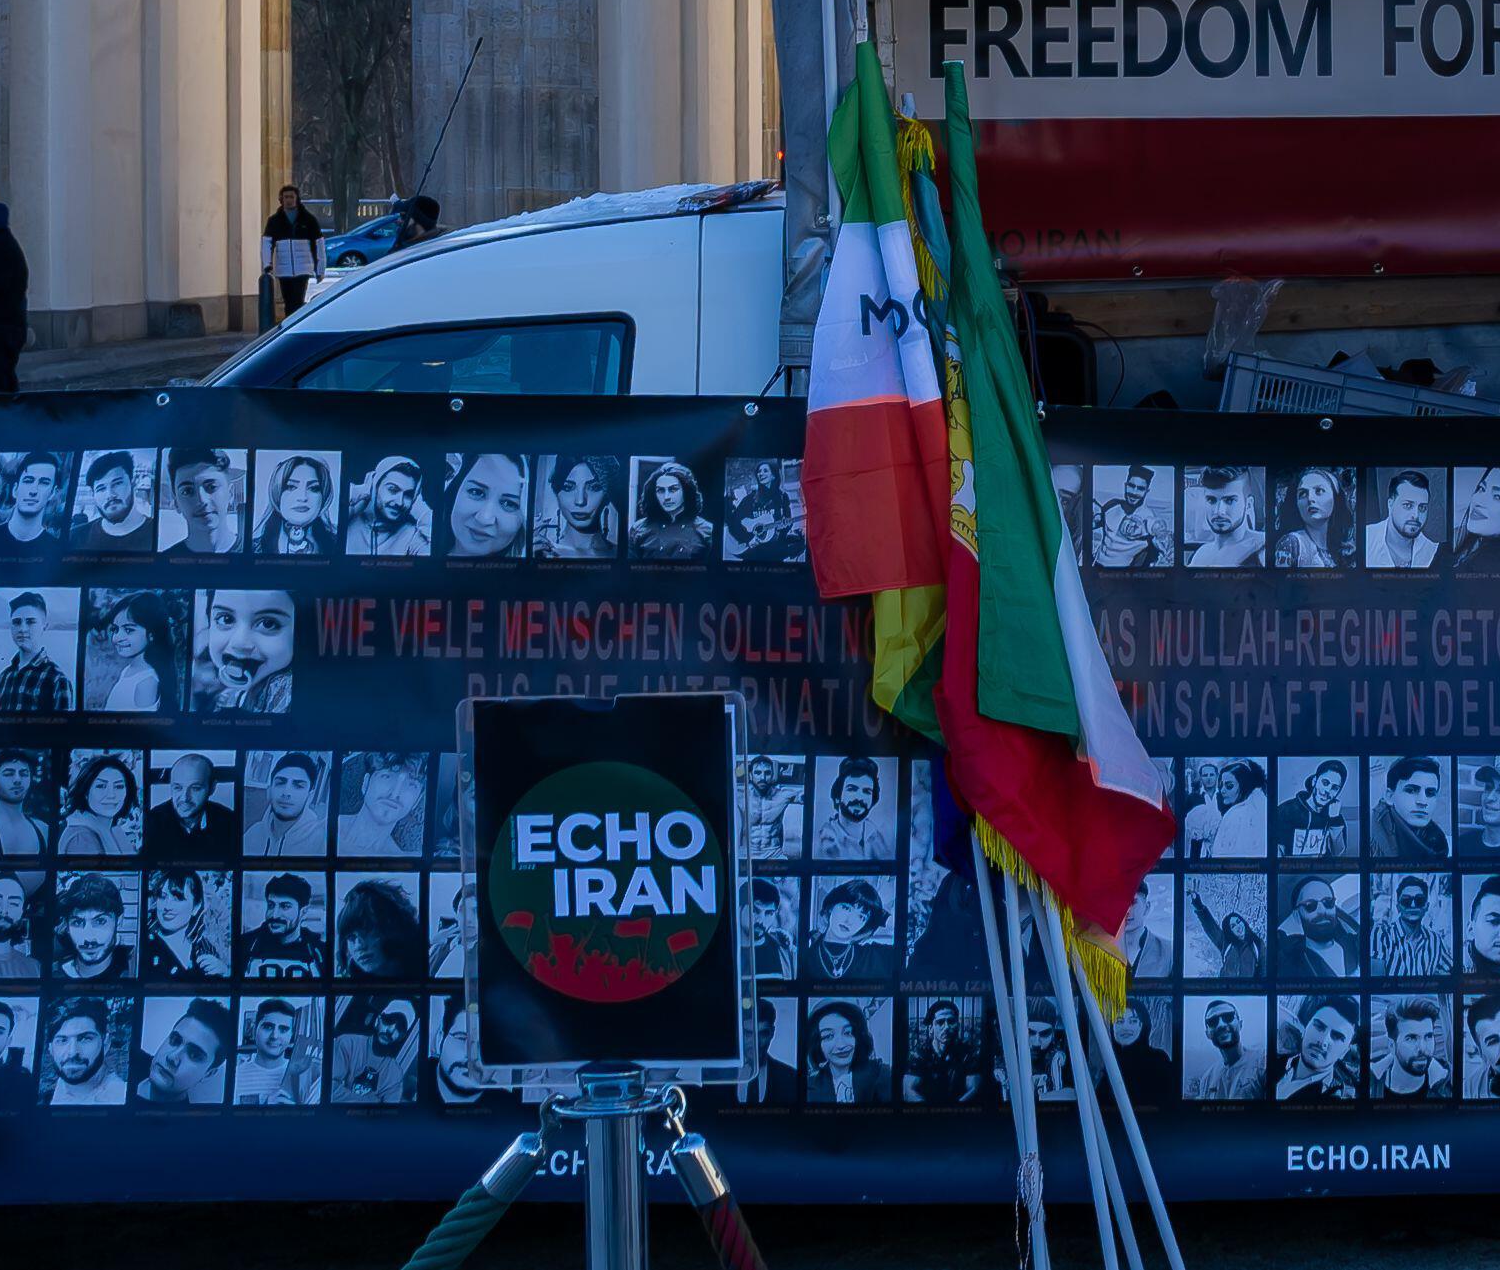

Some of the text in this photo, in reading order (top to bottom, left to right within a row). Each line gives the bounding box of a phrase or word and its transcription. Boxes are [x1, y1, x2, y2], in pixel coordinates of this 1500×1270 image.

[316, 598, 376, 657] WIE
[391, 598, 485, 659] VIELE
[500, 600, 684, 661] MENSCHEN
[697, 602, 825, 662] SOLLEN
[1150, 609, 1418, 667] MULLAH-REGIME
[516, 810, 707, 864] ECHO
[553, 865, 717, 917] IRAN
[1287, 1144, 1451, 1171] ECHO.IRAN
